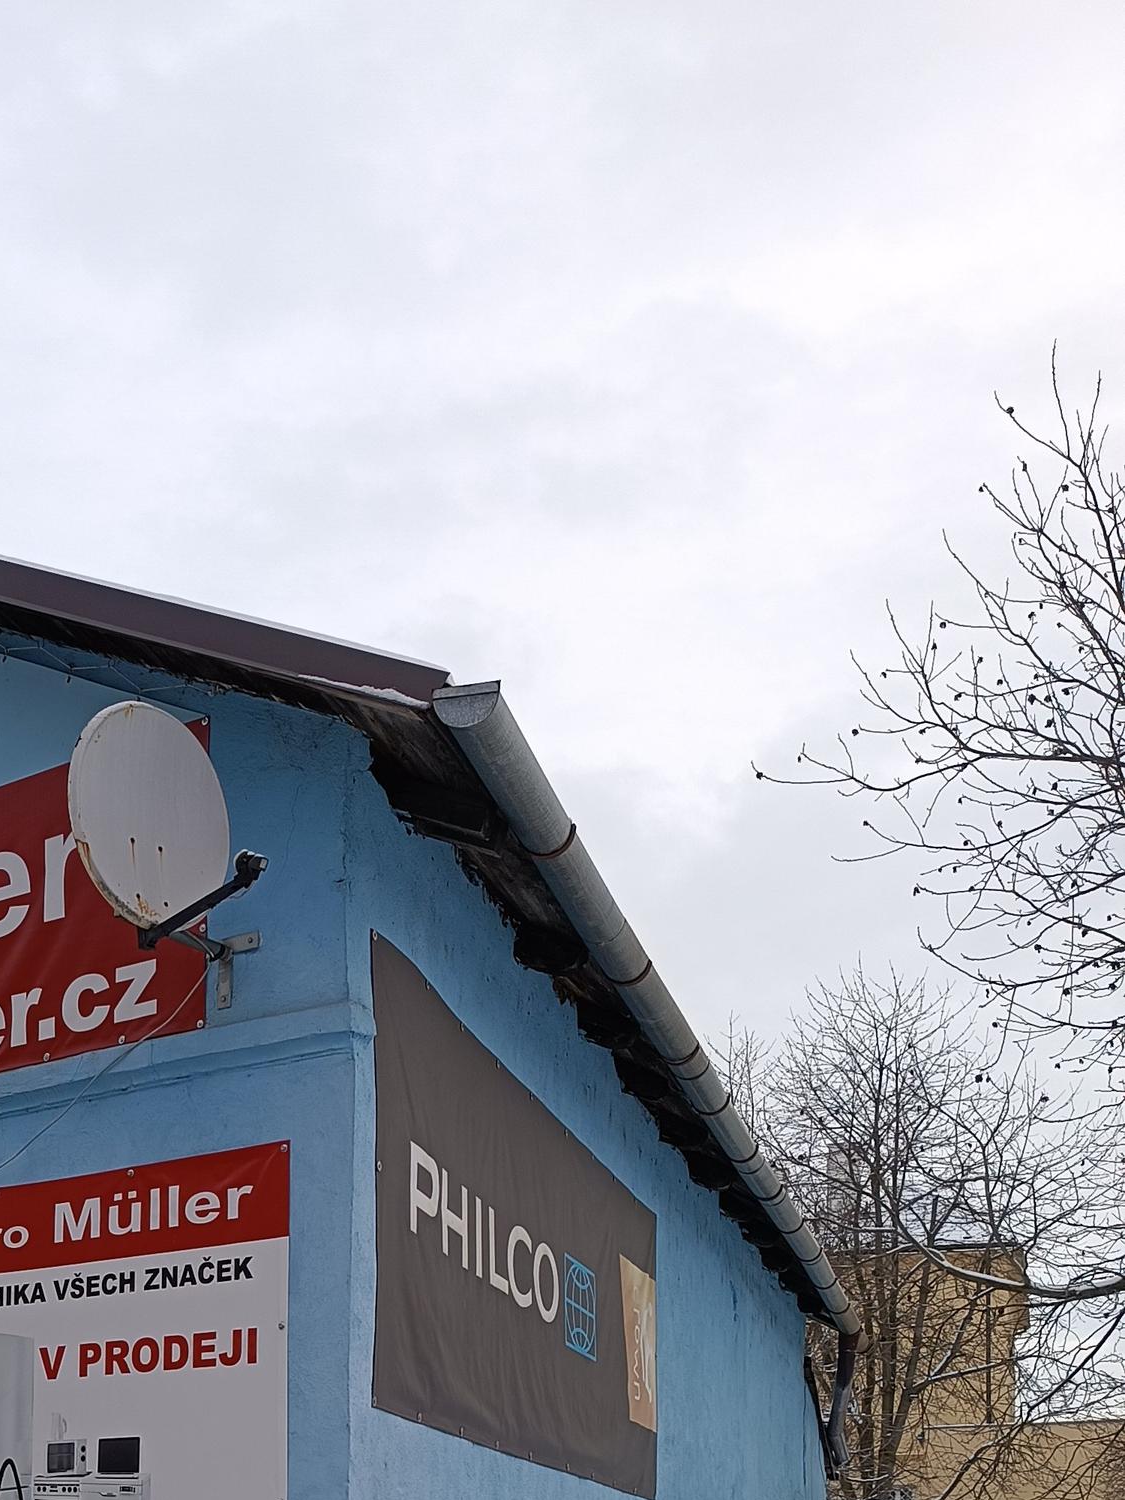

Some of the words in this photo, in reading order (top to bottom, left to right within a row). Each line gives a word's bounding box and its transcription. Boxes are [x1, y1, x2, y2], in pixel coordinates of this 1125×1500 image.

[53, 1181, 253, 1244] Müller
[410, 1140, 560, 1324] PHILCO
[53, 1269, 136, 1300] VŠECH
[145, 1256, 253, 1290] ZNAČEK
[39, 1346, 66, 1381] V
[79, 1328, 258, 1378] PRODEJI
